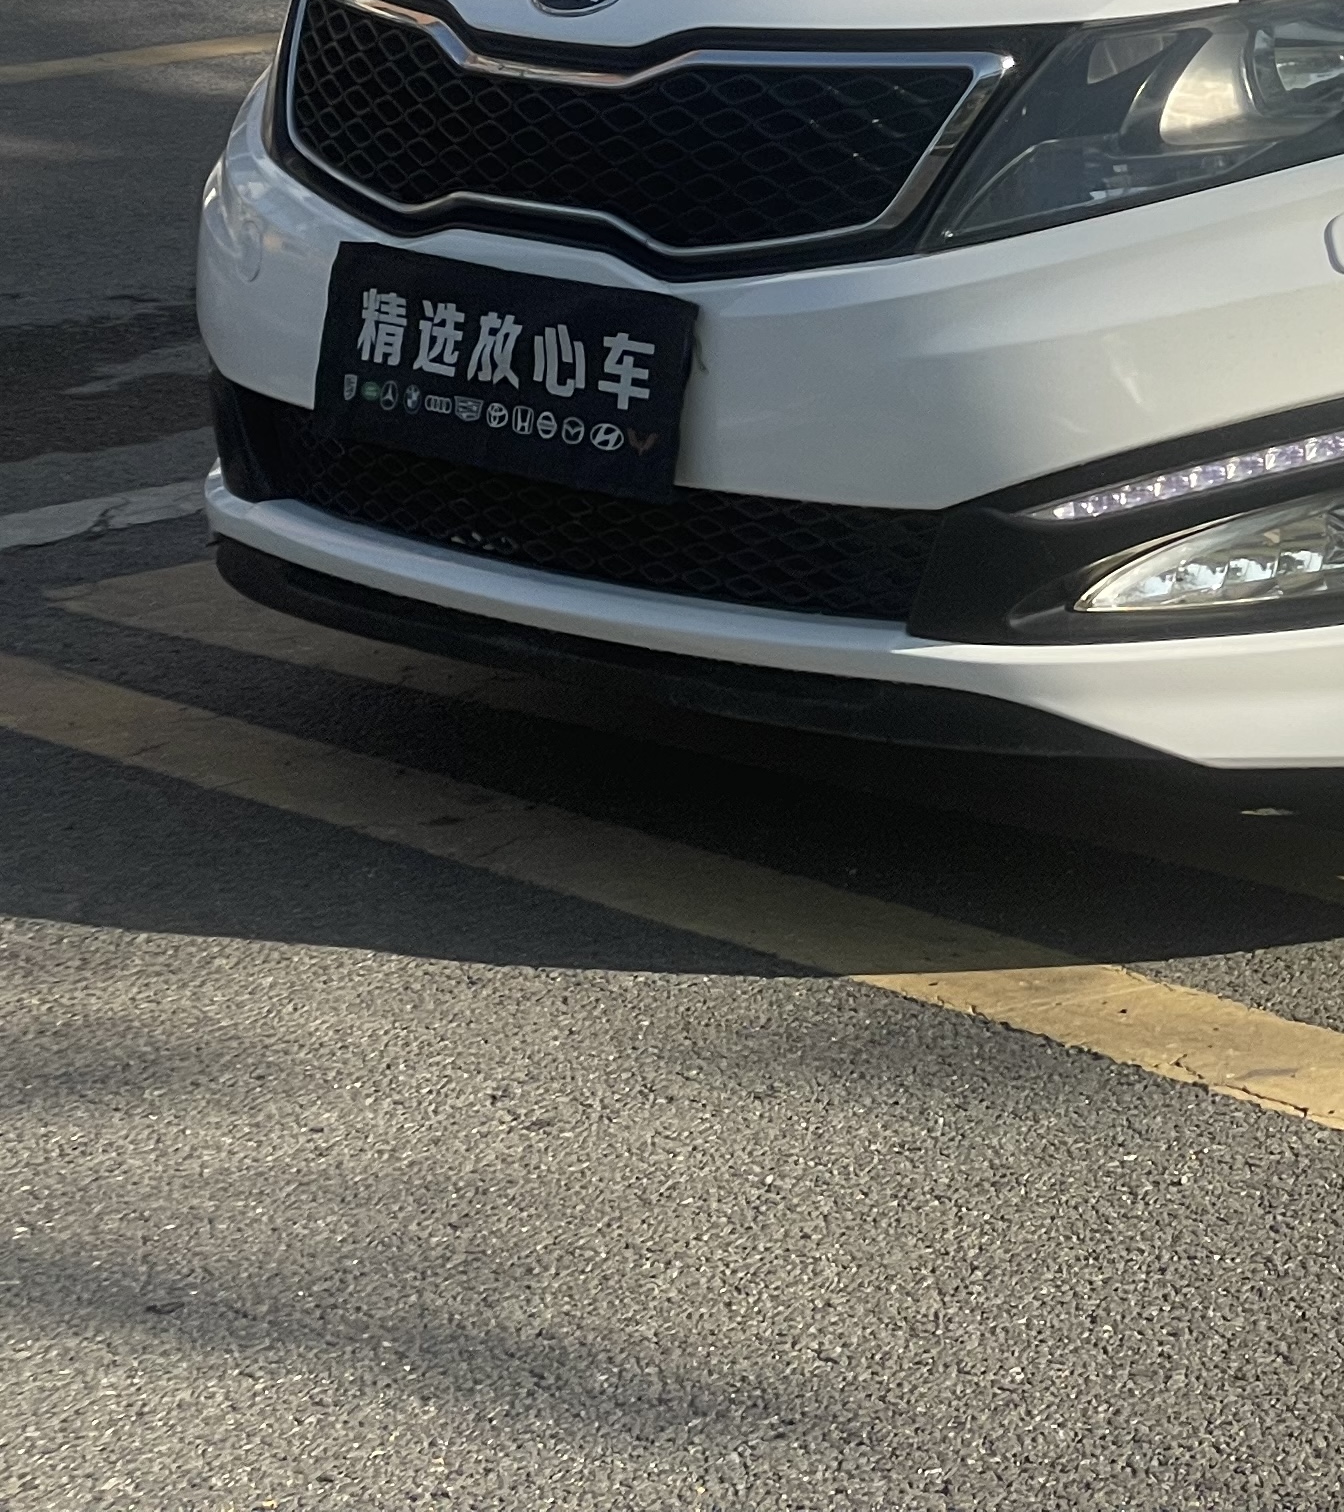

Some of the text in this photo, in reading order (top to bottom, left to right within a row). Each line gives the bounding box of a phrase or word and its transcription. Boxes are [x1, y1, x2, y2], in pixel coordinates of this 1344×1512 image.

[356, 287, 656, 411] 精选放心车
